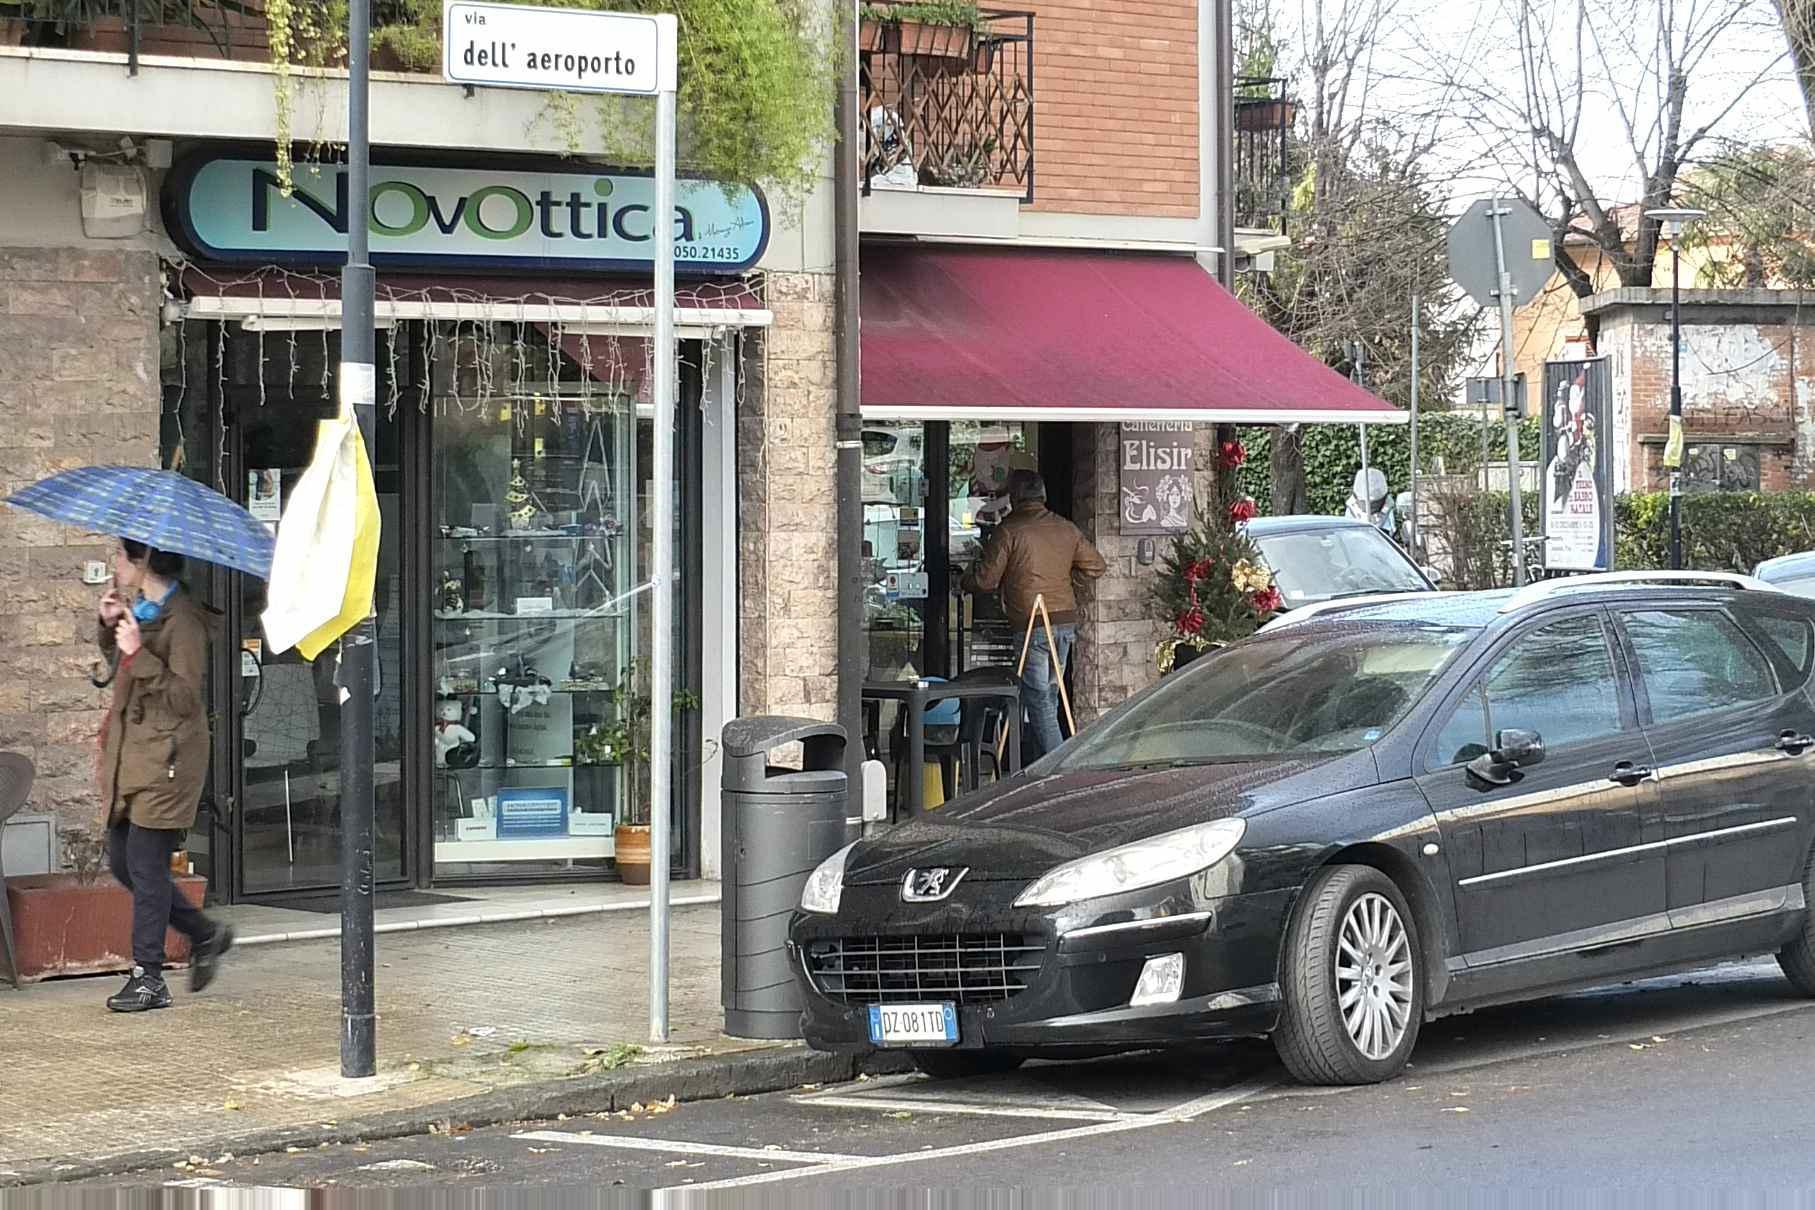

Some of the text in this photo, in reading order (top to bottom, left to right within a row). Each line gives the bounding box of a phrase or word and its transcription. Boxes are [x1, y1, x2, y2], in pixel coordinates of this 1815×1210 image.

[465, 13, 487, 25] via
[463, 40, 636, 79] dell' aeroporto
[674, 246, 739, 260] 050.21435
[1123, 439, 1192, 470] Elisir
